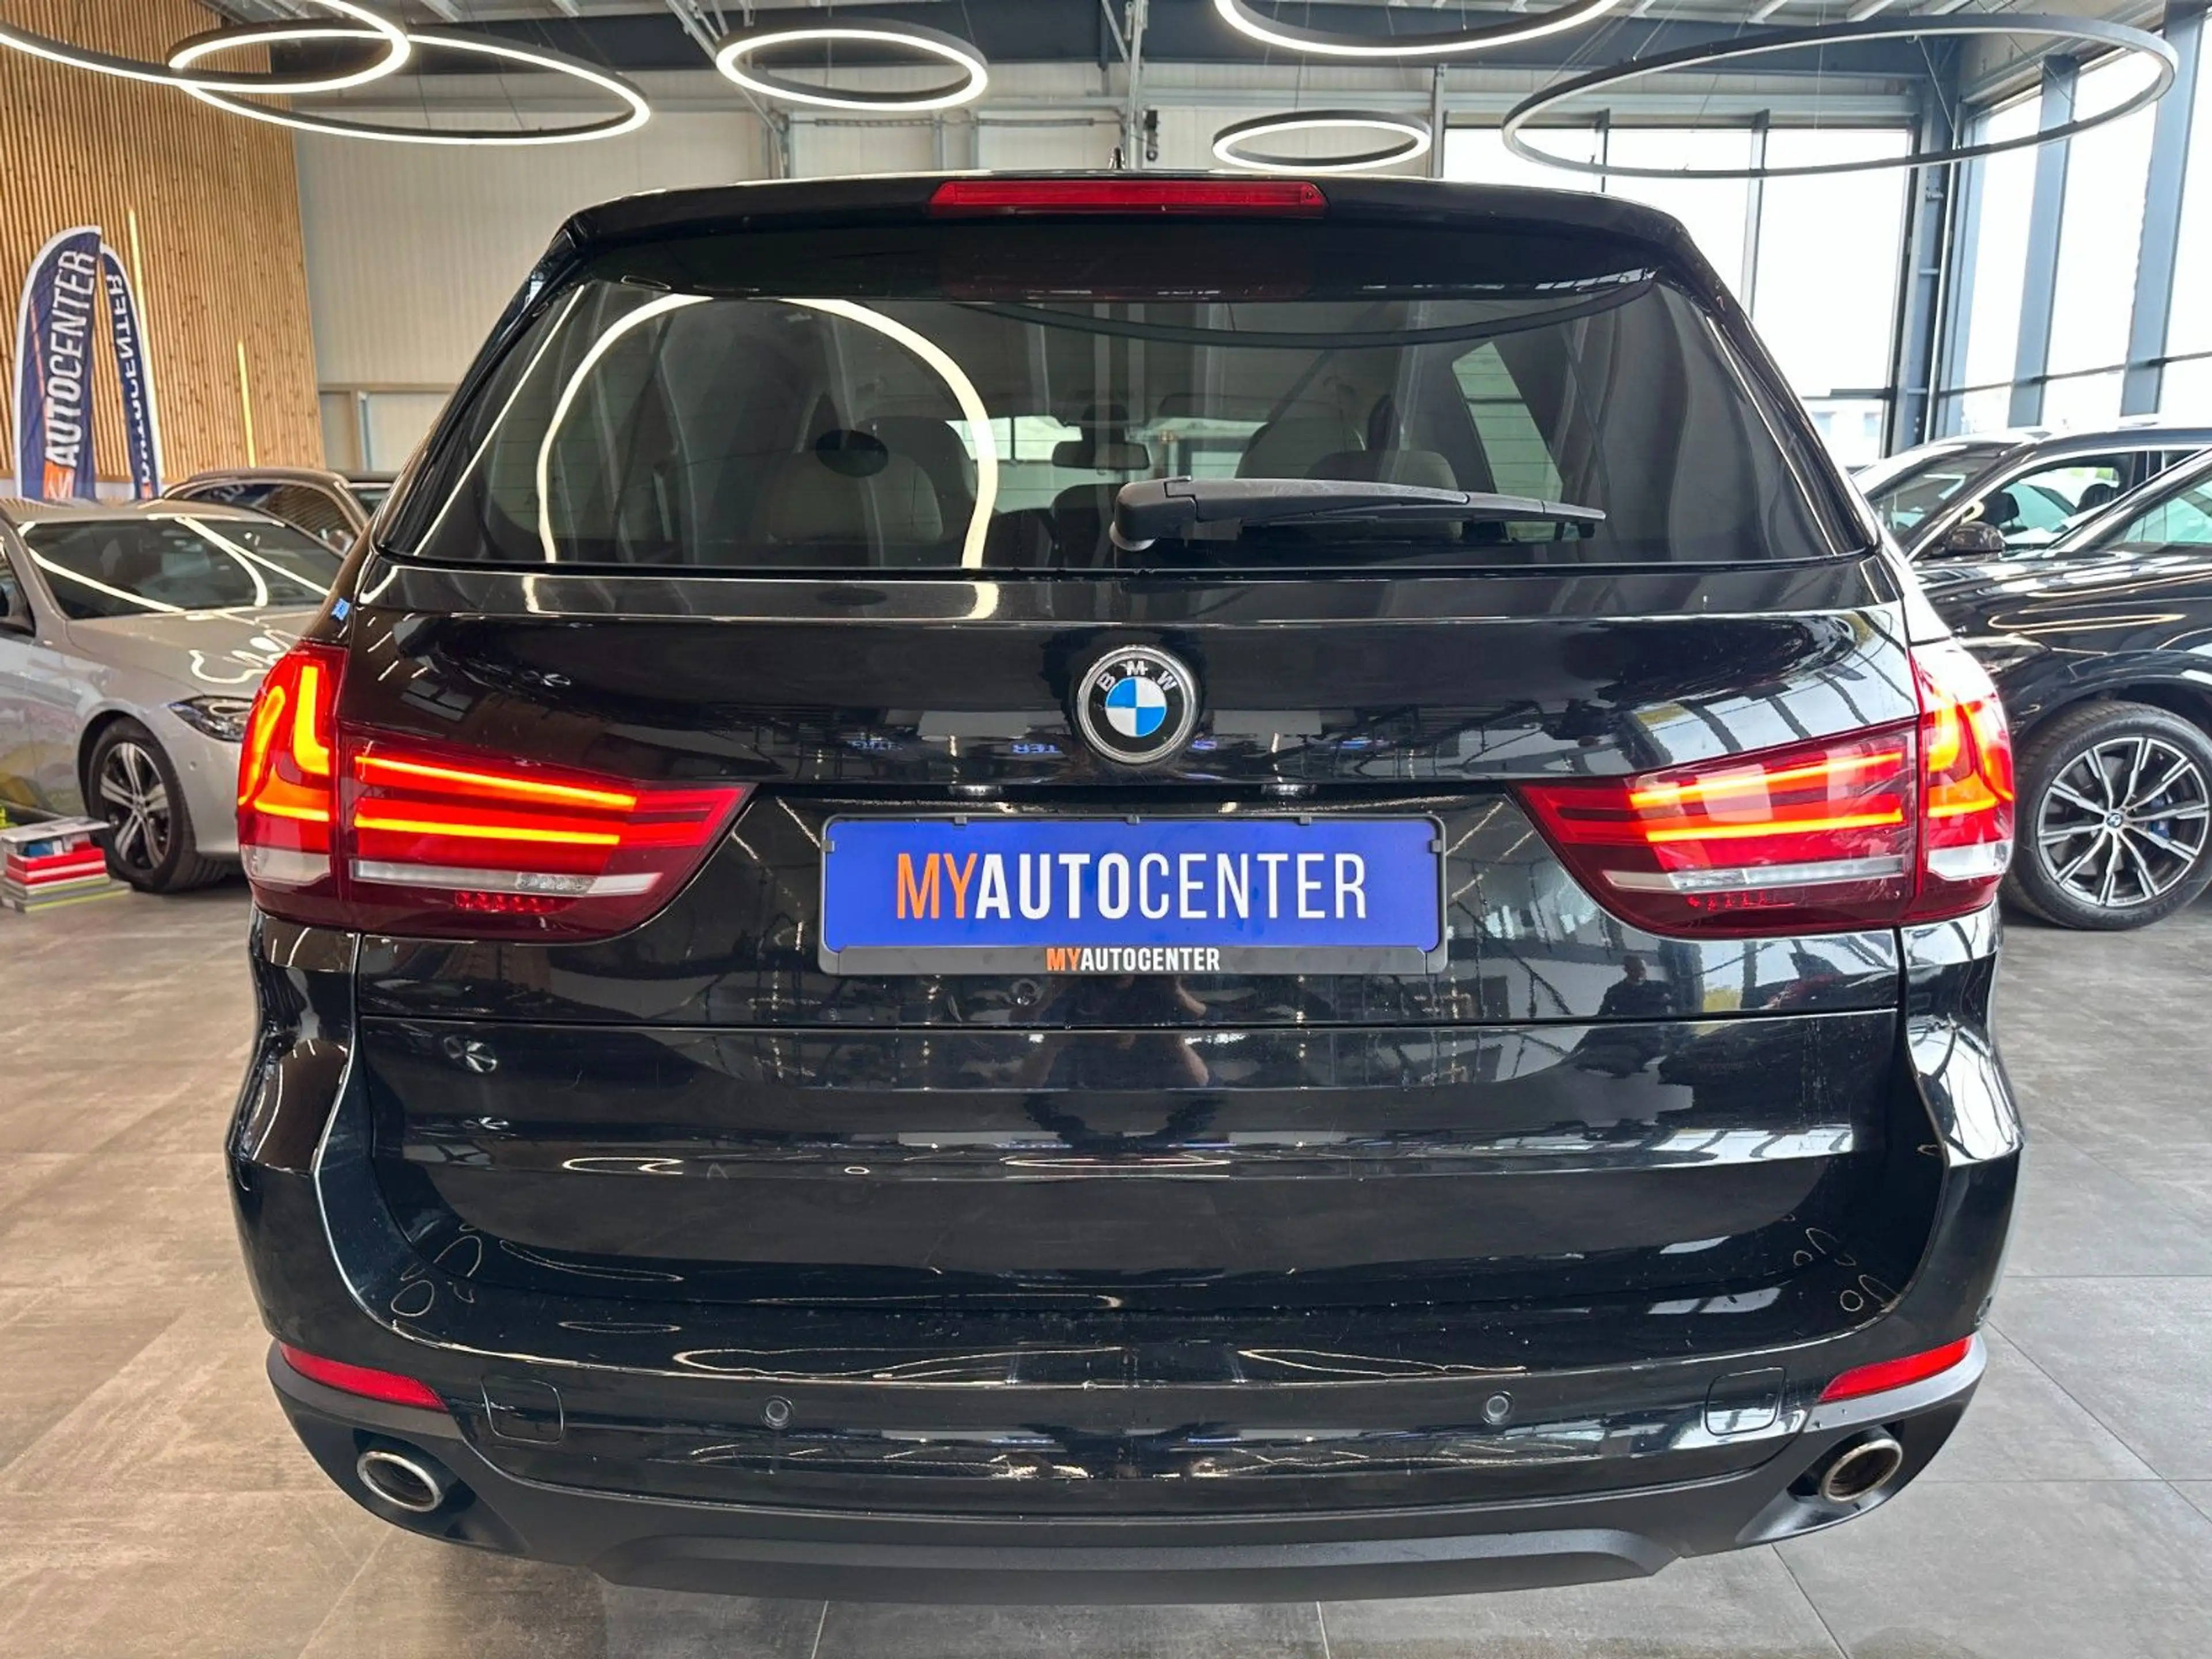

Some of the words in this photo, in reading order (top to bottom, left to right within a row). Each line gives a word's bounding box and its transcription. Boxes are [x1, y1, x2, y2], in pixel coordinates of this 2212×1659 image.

[1096, 661, 1177, 692] BMW
[897, 853, 1366, 919] MYAUTOCENTER
[1046, 947, 1220, 971] MYAUTOCENTER
